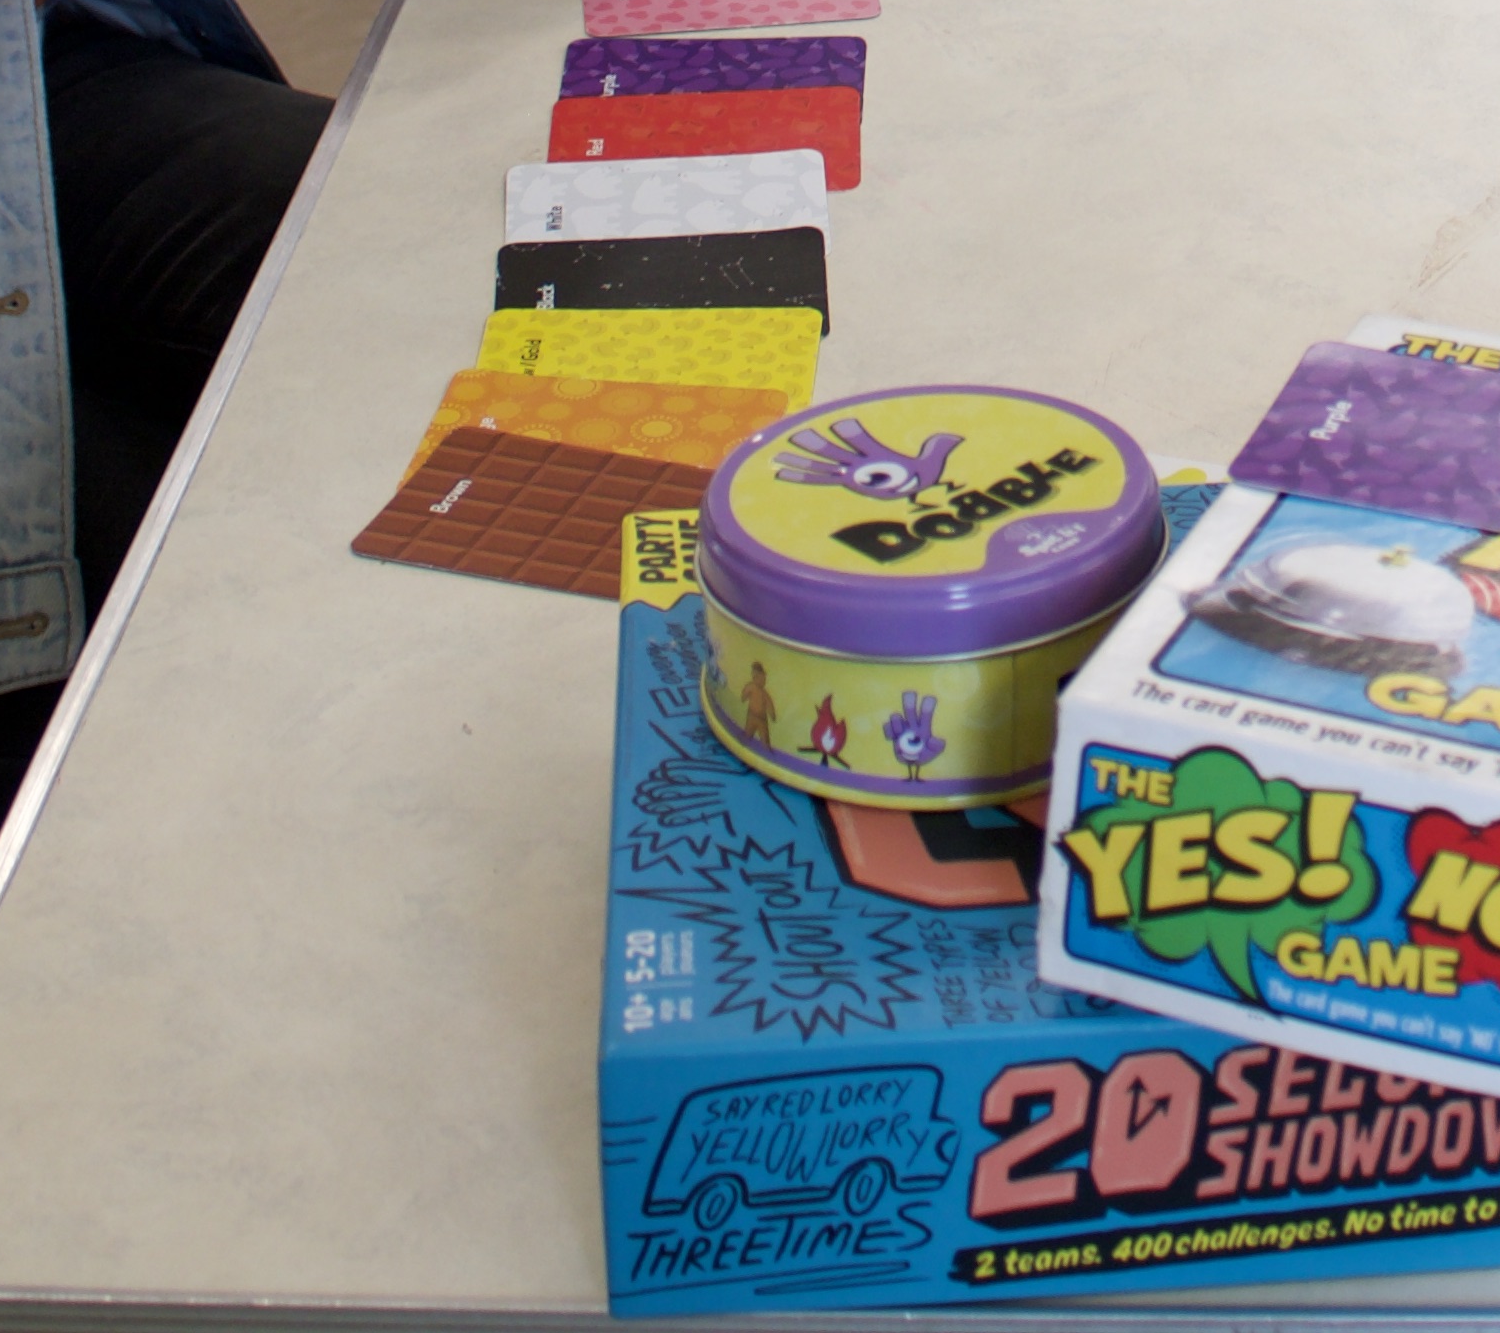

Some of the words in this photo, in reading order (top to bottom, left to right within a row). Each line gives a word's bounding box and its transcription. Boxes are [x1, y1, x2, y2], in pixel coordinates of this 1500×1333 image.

[603, 73, 619, 98] urple
[586, 138, 604, 157] Red
[546, 205, 563, 233] White
[536, 283, 555, 311] Black
[522, 338, 542, 361] Gold
[1309, 399, 1353, 442] Purple
[429, 478, 473, 516] Brown
[829, 448, 1100, 565] DOBBLE
[635, 513, 677, 586] PARTY
[1132, 680, 1175, 705] The
[1182, 692, 1235, 718] card
[1238, 709, 1309, 735] game
[1317, 723, 1362, 748] you
[1370, 736, 1429, 762] can't
[1436, 750, 1481, 773] say
[1091, 757, 1175, 807] THE
[1063, 791, 1360, 921] YES!
[740, 867, 800, 910] OUT
[625, 930, 656, 984] 5-20
[758, 910, 867, 1005] SHOUT
[918, 918, 958, 971] TYPES
[974, 925, 1010, 995] YELLOW
[1275, 932, 1462, 996] GAME
[622, 992, 656, 1034] 10+
[930, 973, 974, 1029] THREE
[982, 997, 1014, 1024] OF
[1268, 978, 1294, 1004] The
[1296, 991, 1328, 1014] card
[1327, 1000, 1370, 1023] game
[1371, 1009, 1398, 1031] you
[1400, 1013, 1435, 1039] can't
[1437, 1025, 1464, 1051] say
[705, 1094, 758, 1125] SAY
[758, 1088, 815, 1120] RED
[819, 1077, 913, 1115] LORRY
[681, 1123, 822, 1185] YELLOW
[969, 1048, 1202, 1220] 20
[628, 1225, 766, 1282] THREE
[755, 1200, 934, 1268] TIMES
[974, 1253, 998, 1280] 2
[1003, 1242, 1103, 1275] teams.
[1112, 1235, 1175, 1264] 400
[1174, 1214, 1337, 1258] challenges.
[1344, 1207, 1383, 1236] No
[1385, 1201, 1457, 1229] time
[1463, 1196, 1496, 1224] to
